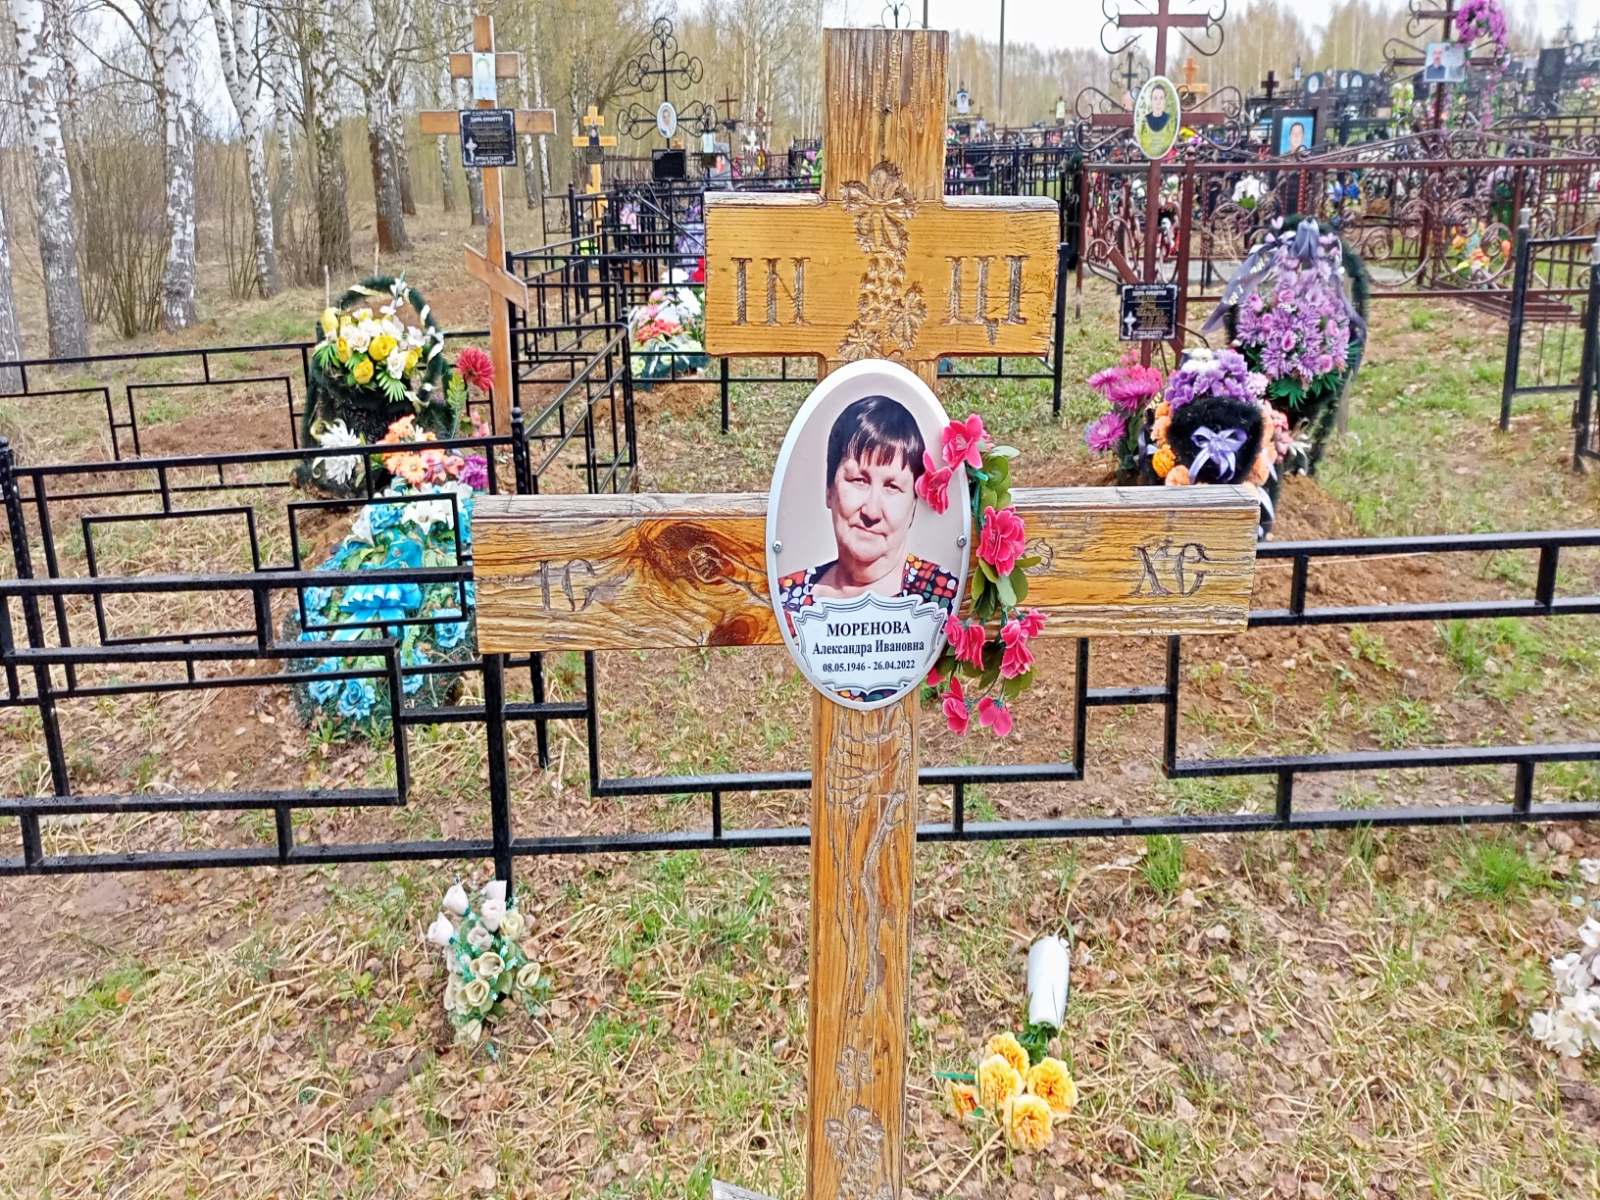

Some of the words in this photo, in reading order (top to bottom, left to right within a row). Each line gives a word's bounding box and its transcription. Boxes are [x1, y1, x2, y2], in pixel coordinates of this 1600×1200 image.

[826, 620, 911, 637] МОРЕНОВА
[812, 641, 873, 657] Александра
[874, 639, 925, 653] Ивановна
[822, 662, 866, 673] 08.05.1946
[873, 659, 916, 671] 26.04.2022
